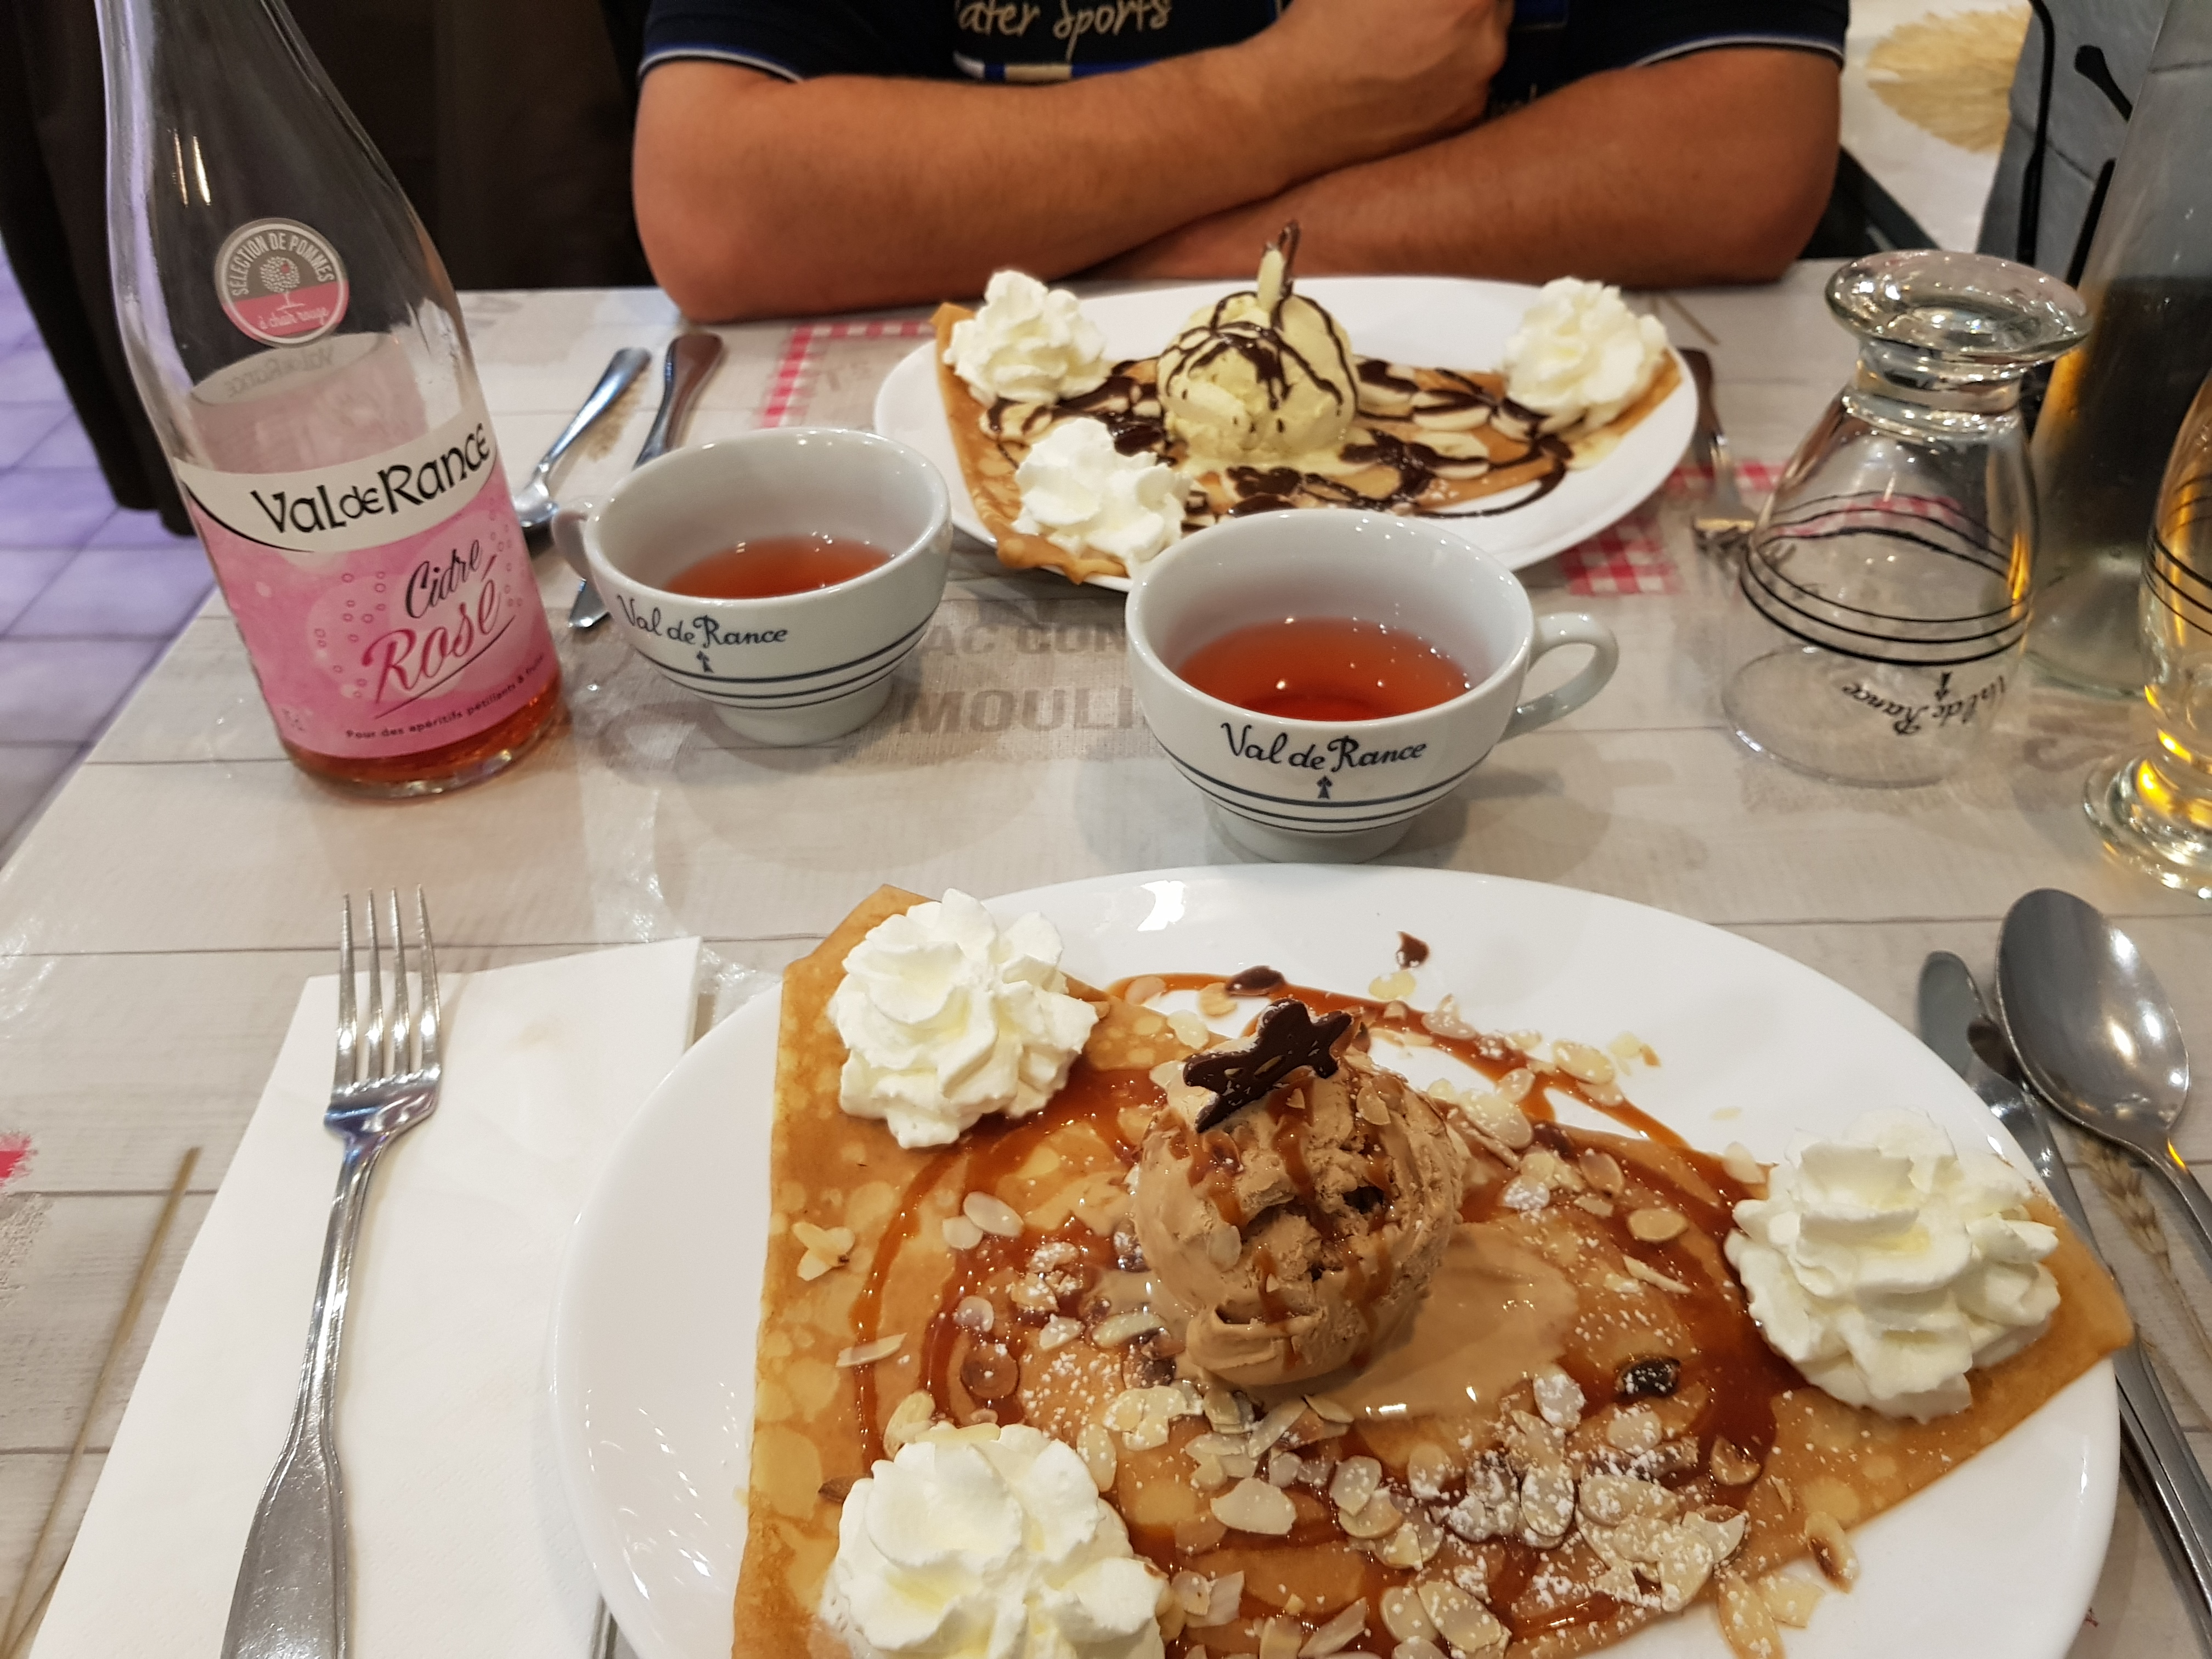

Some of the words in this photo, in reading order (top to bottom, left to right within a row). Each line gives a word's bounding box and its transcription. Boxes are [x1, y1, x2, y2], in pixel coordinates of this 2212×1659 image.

[954, 0, 1041, 36] ater
[268, 232, 286, 250] DE
[289, 235, 335, 283] POMMES
[405, 539, 483, 619] Cidre
[362, 554, 501, 704] Rosé
[617, 595, 662, 636] Val
[667, 620, 696, 645] de
[692, 614, 788, 648] Rance
[381, 726, 404, 736] des
[1220, 722, 1288, 764] Val
[1288, 743, 1326, 770] de
[1327, 735, 1427, 772] Rance
